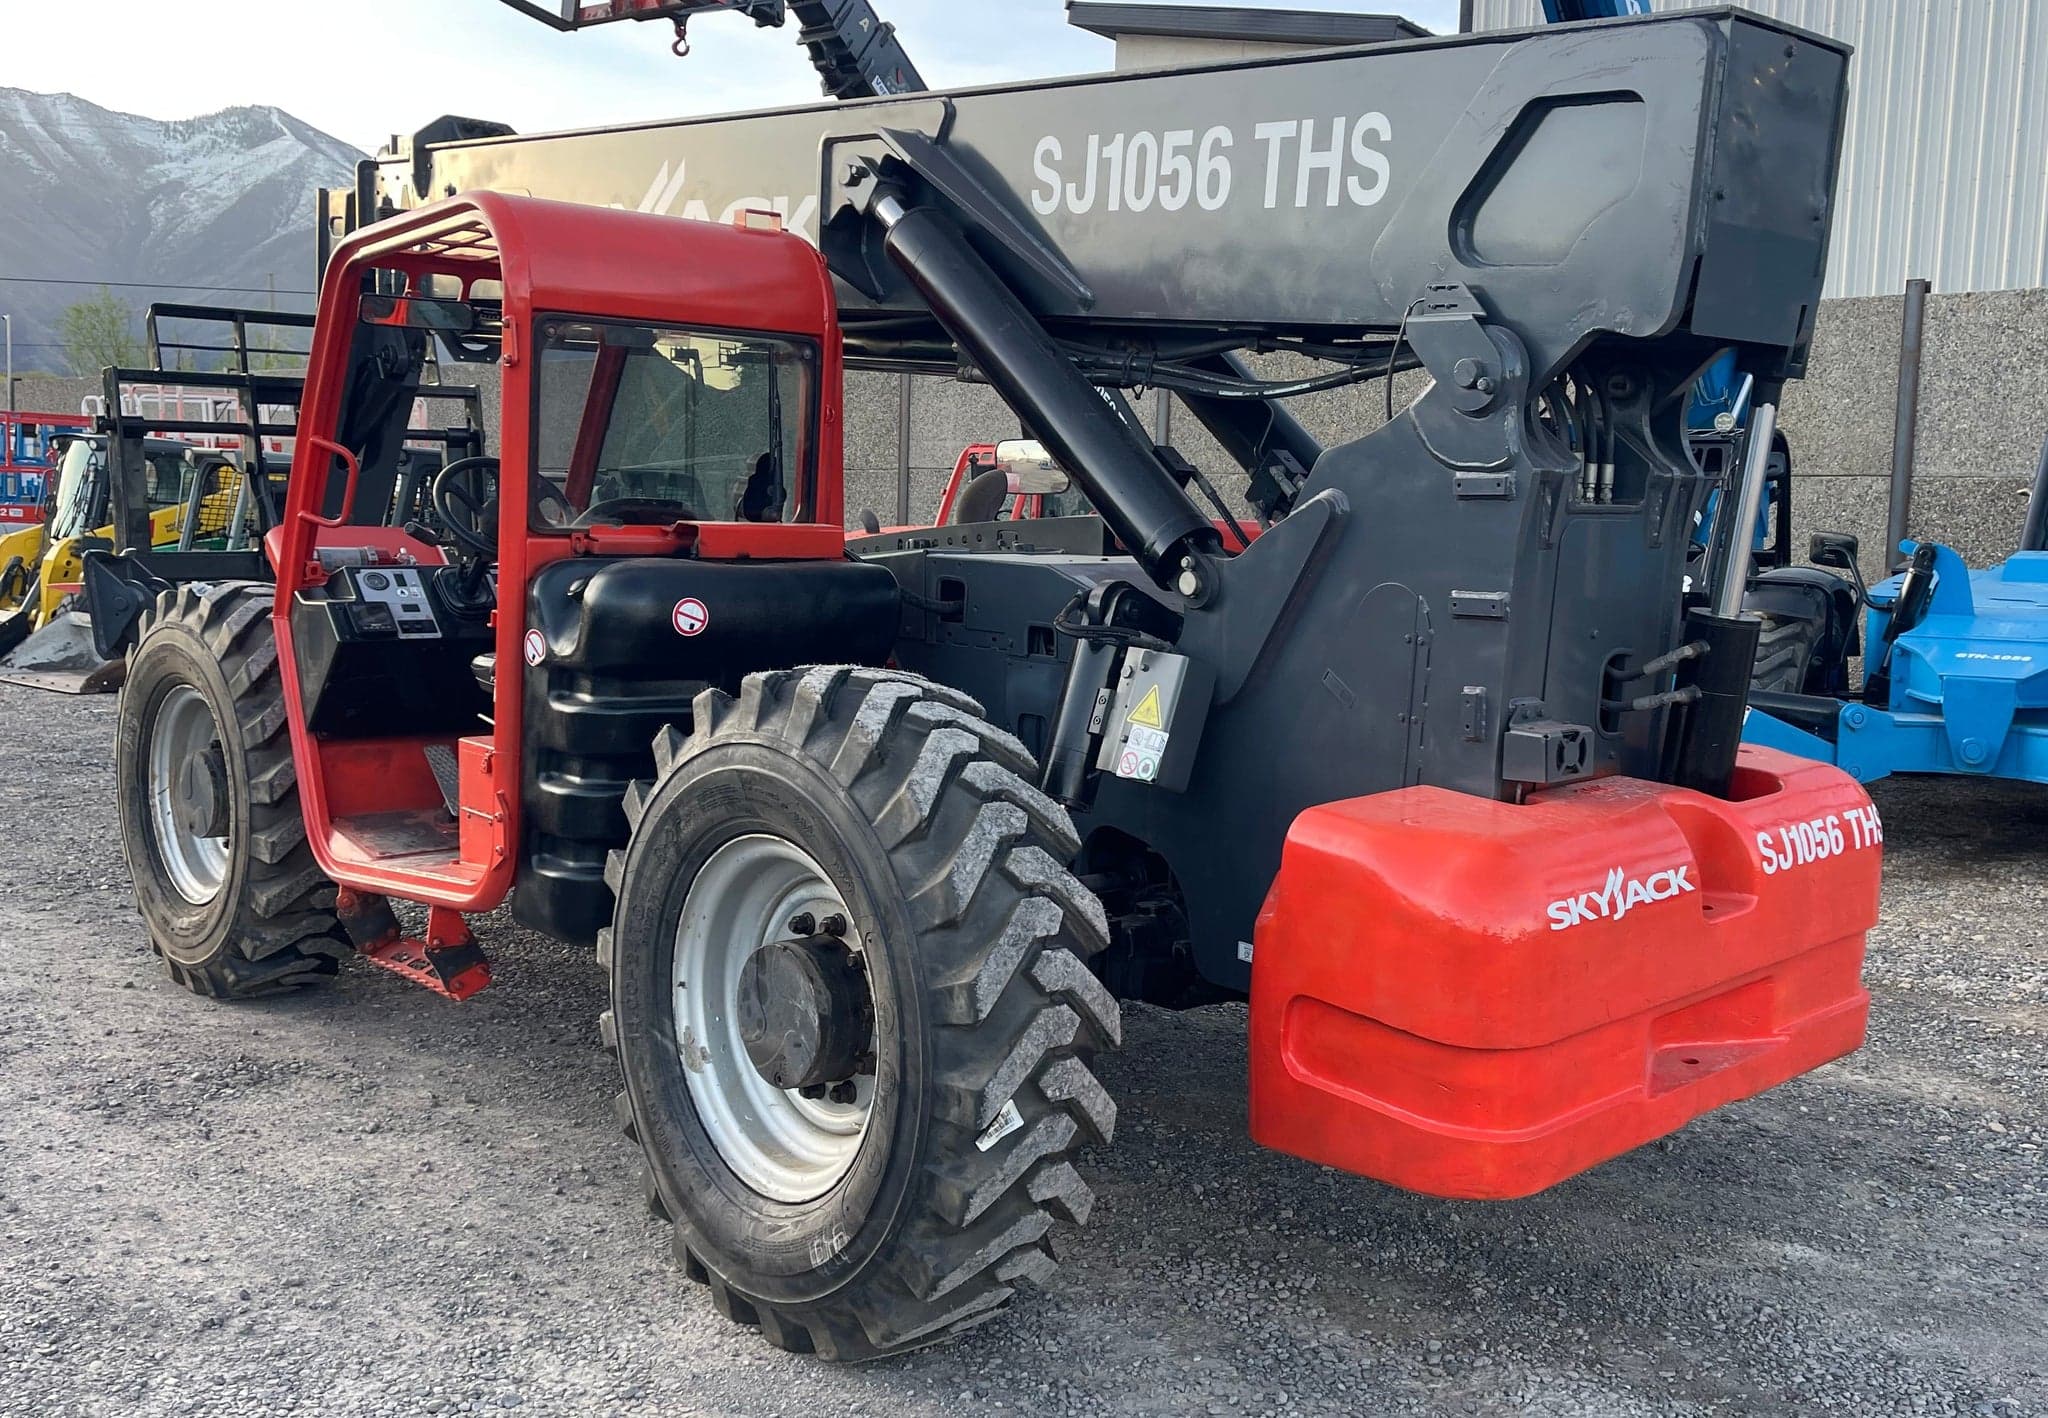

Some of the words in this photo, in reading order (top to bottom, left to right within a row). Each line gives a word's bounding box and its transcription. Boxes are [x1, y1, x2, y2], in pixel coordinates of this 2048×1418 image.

[1031, 125, 1233, 215] SJ1056
[1254, 111, 1392, 208] THS
[1756, 815, 1845, 875] SJ1056
[1546, 866, 1696, 931] SKYJACK
